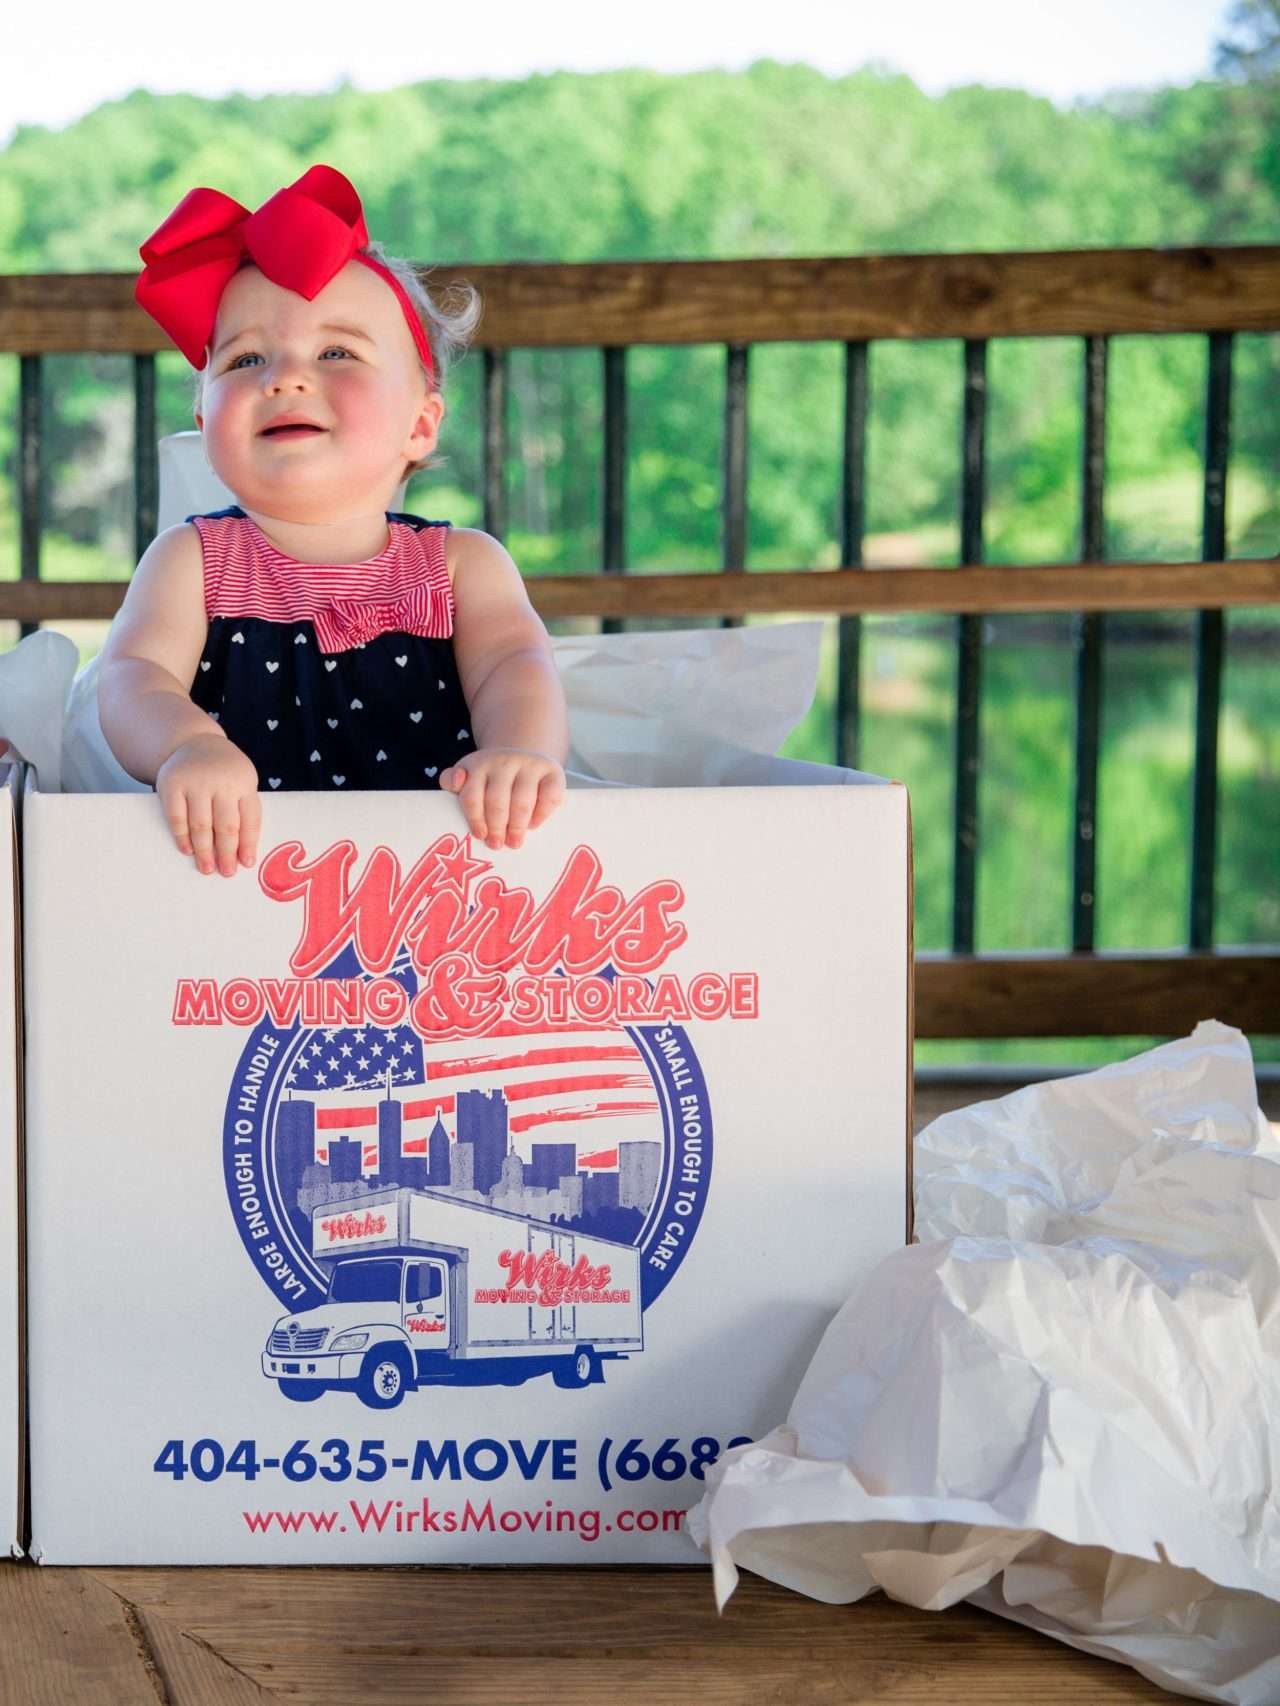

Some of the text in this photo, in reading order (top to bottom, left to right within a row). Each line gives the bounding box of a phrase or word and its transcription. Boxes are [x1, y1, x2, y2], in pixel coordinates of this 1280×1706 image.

[258, 833, 687, 978] Wirks
[172, 953, 758, 1041] MOVING & STORAGE
[234, 1034, 307, 1300] LARGE ENOUGH TO HANDLE
[648, 1027, 702, 1271] SMALL ENOUGH TO CARE
[321, 1212, 387, 1242] Wirks
[474, 1284, 631, 1307] MOVING & STORAGE
[498, 1249, 612, 1290] Wirks
[153, 1436, 755, 1492] 404-635-MOVE (668
[242, 1497, 688, 1542] www.WirksMoving.com
